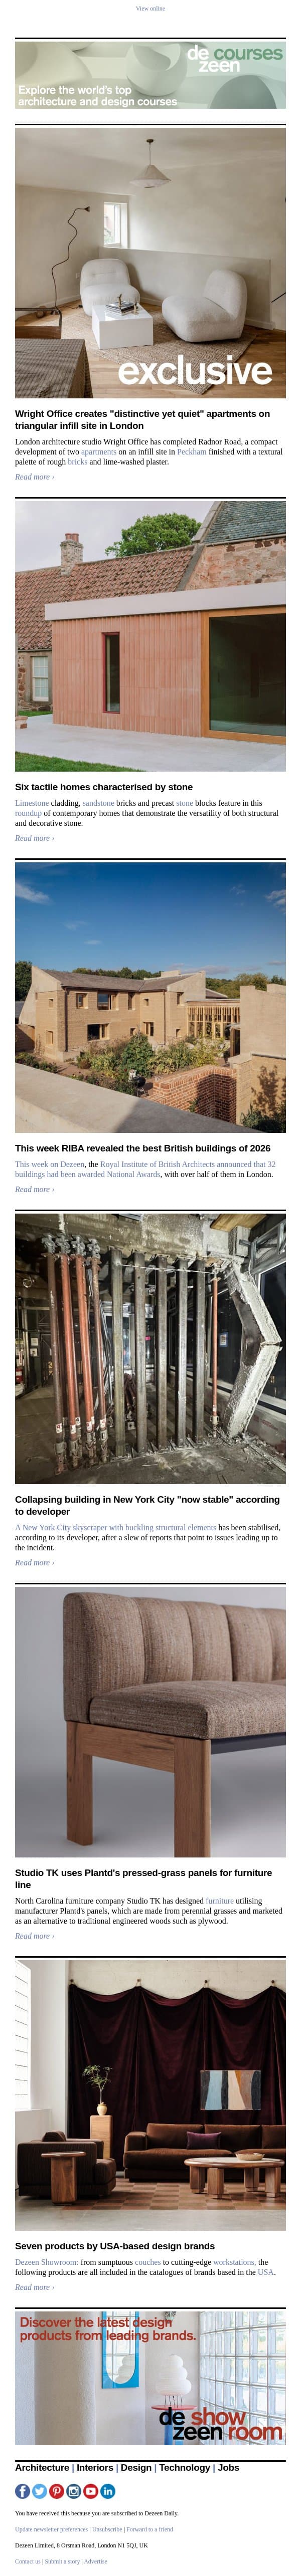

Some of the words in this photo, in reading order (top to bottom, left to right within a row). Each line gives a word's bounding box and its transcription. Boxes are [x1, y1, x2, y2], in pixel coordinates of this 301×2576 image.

[187, 45, 209, 60] de
[214, 48, 283, 61] courses
[199, 60, 240, 73] zeen
[18, 85, 56, 96] Explore
[59, 85, 75, 95] the
[115, 86, 131, 96] top
[18, 97, 77, 106] architecture
[80, 97, 98, 106] and
[101, 97, 134, 108] design
[14, 410, 45, 419] Wright
[110, 409, 160, 417] "distinctive
[161, 410, 176, 419] yet
[178, 410, 204, 419] quiet"
[206, 410, 257, 419] apartments
[15, 422, 58, 431] triangular
[60, 421, 79, 429] infill
[110, 421, 144, 429] London
[103, 438, 126, 447] Wright
[163, 437, 197, 447] completed
[224, 438, 243, 446] Road,
[250, 439, 278, 447] compact
[155, 783, 167, 793] by
[15, 1144, 35, 1152] This
[62, 1144, 85, 1152] RIBA
[164, 1144, 193, 1152] British
[195, 1144, 237, 1154] buildings
[15, 1496, 62, 1505] Collapsing
[65, 1495, 100, 1505] building
[113, 1495, 133, 1503] New
[134, 1496, 156, 1504] York
[157, 1496, 175, 1505] City
[177, 1495, 201, 1503] "now
[202, 1495, 233, 1503] stable"
[235, 1496, 280, 1505] according
[26, 1507, 71, 1517] developer
[15, 1868, 44, 1877] Studio
[122, 1869, 186, 1879] pressed-grass
[188, 1868, 217, 1879] panels
[15, 1881, 31, 1889] line
[45, 2242, 85, 2252] products
[86, 2242, 98, 2252] by
[152, 2242, 182, 2252] design
[184, 2242, 215, 2250] brands
[98, 2259, 133, 2267] sumptuous
[171, 2258, 212, 2267] cutting-edge
[213, 2258, 256, 2266] workstations,
[20, 2316, 71, 2327] Discover
[75, 2316, 93, 2327] the
[97, 2316, 129, 2327] latest
[132, 2316, 172, 2329] design
[20, 2330, 72, 2343] products
[75, 2330, 102, 2340] from
[106, 2330, 149, 2343] leading
[153, 2330, 196, 2340] brands.
[159, 2407, 185, 2426] de
[191, 2407, 246, 2426] show
[173, 2426, 222, 2440] zeen
[228, 2426, 282, 2440] room
[15, 2463, 70, 2471] Architecture
[120, 2464, 152, 2473] Design
[158, 2463, 211, 2473] Technology
[217, 2463, 240, 2471] Jobs
[103, 2487, 113, 2495] in
